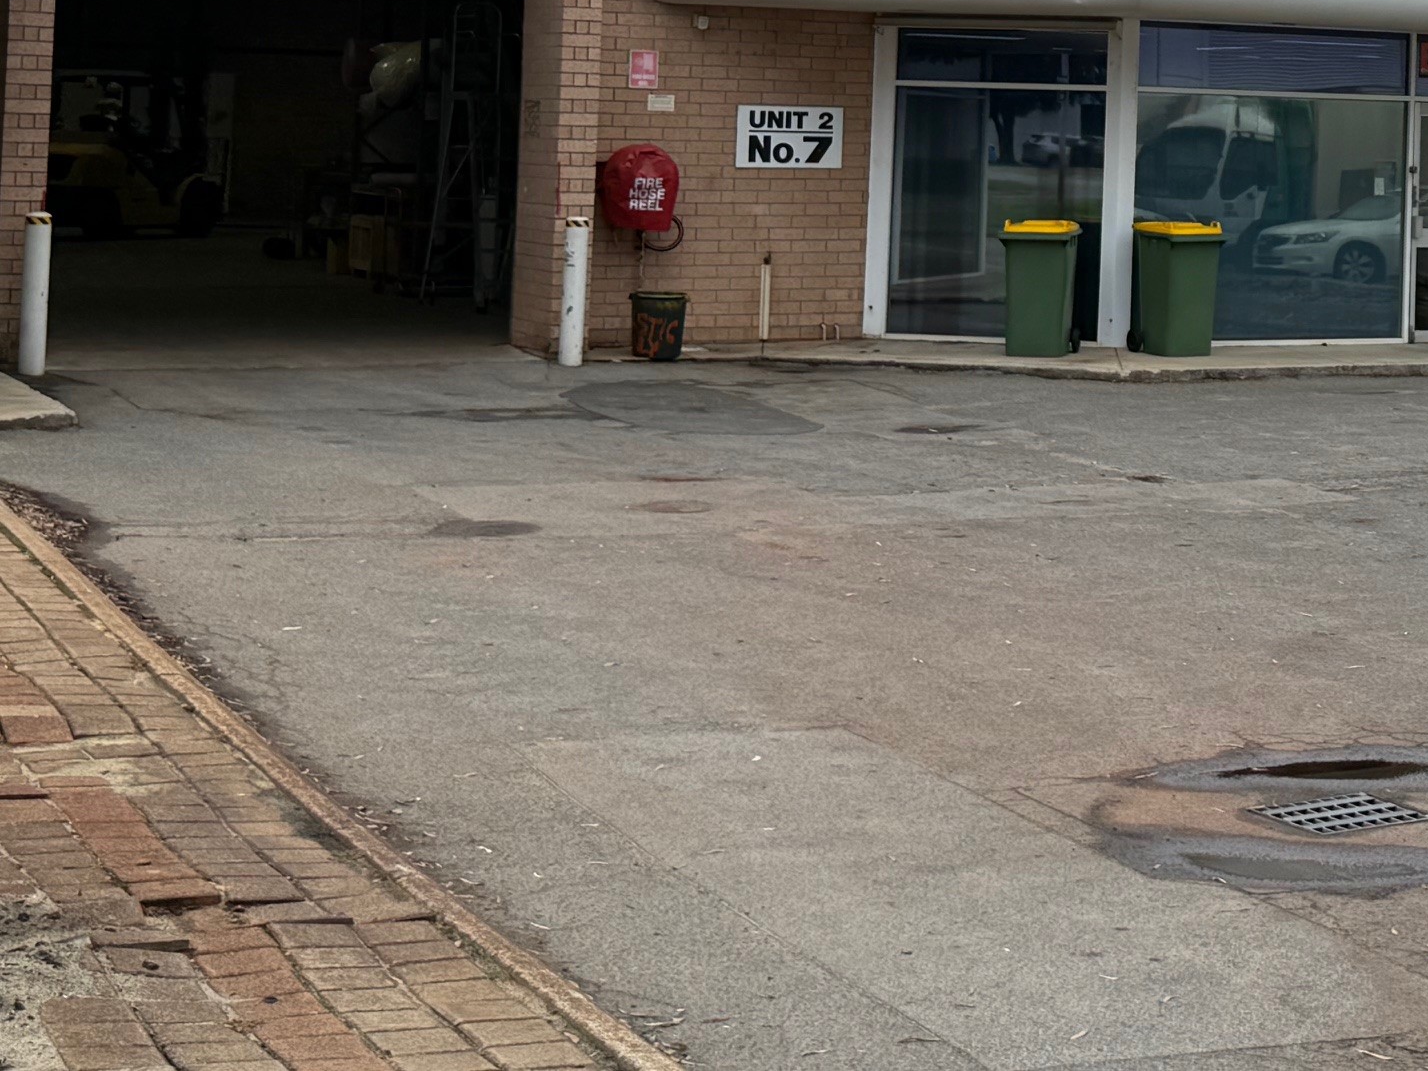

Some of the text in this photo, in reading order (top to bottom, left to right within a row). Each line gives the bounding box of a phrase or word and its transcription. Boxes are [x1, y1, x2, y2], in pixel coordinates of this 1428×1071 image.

[748, 110, 834, 129] UNIT 2
[634, 178, 664, 189] FIRE
[629, 188, 666, 200] HOSE
[629, 199, 664, 211] REEL
